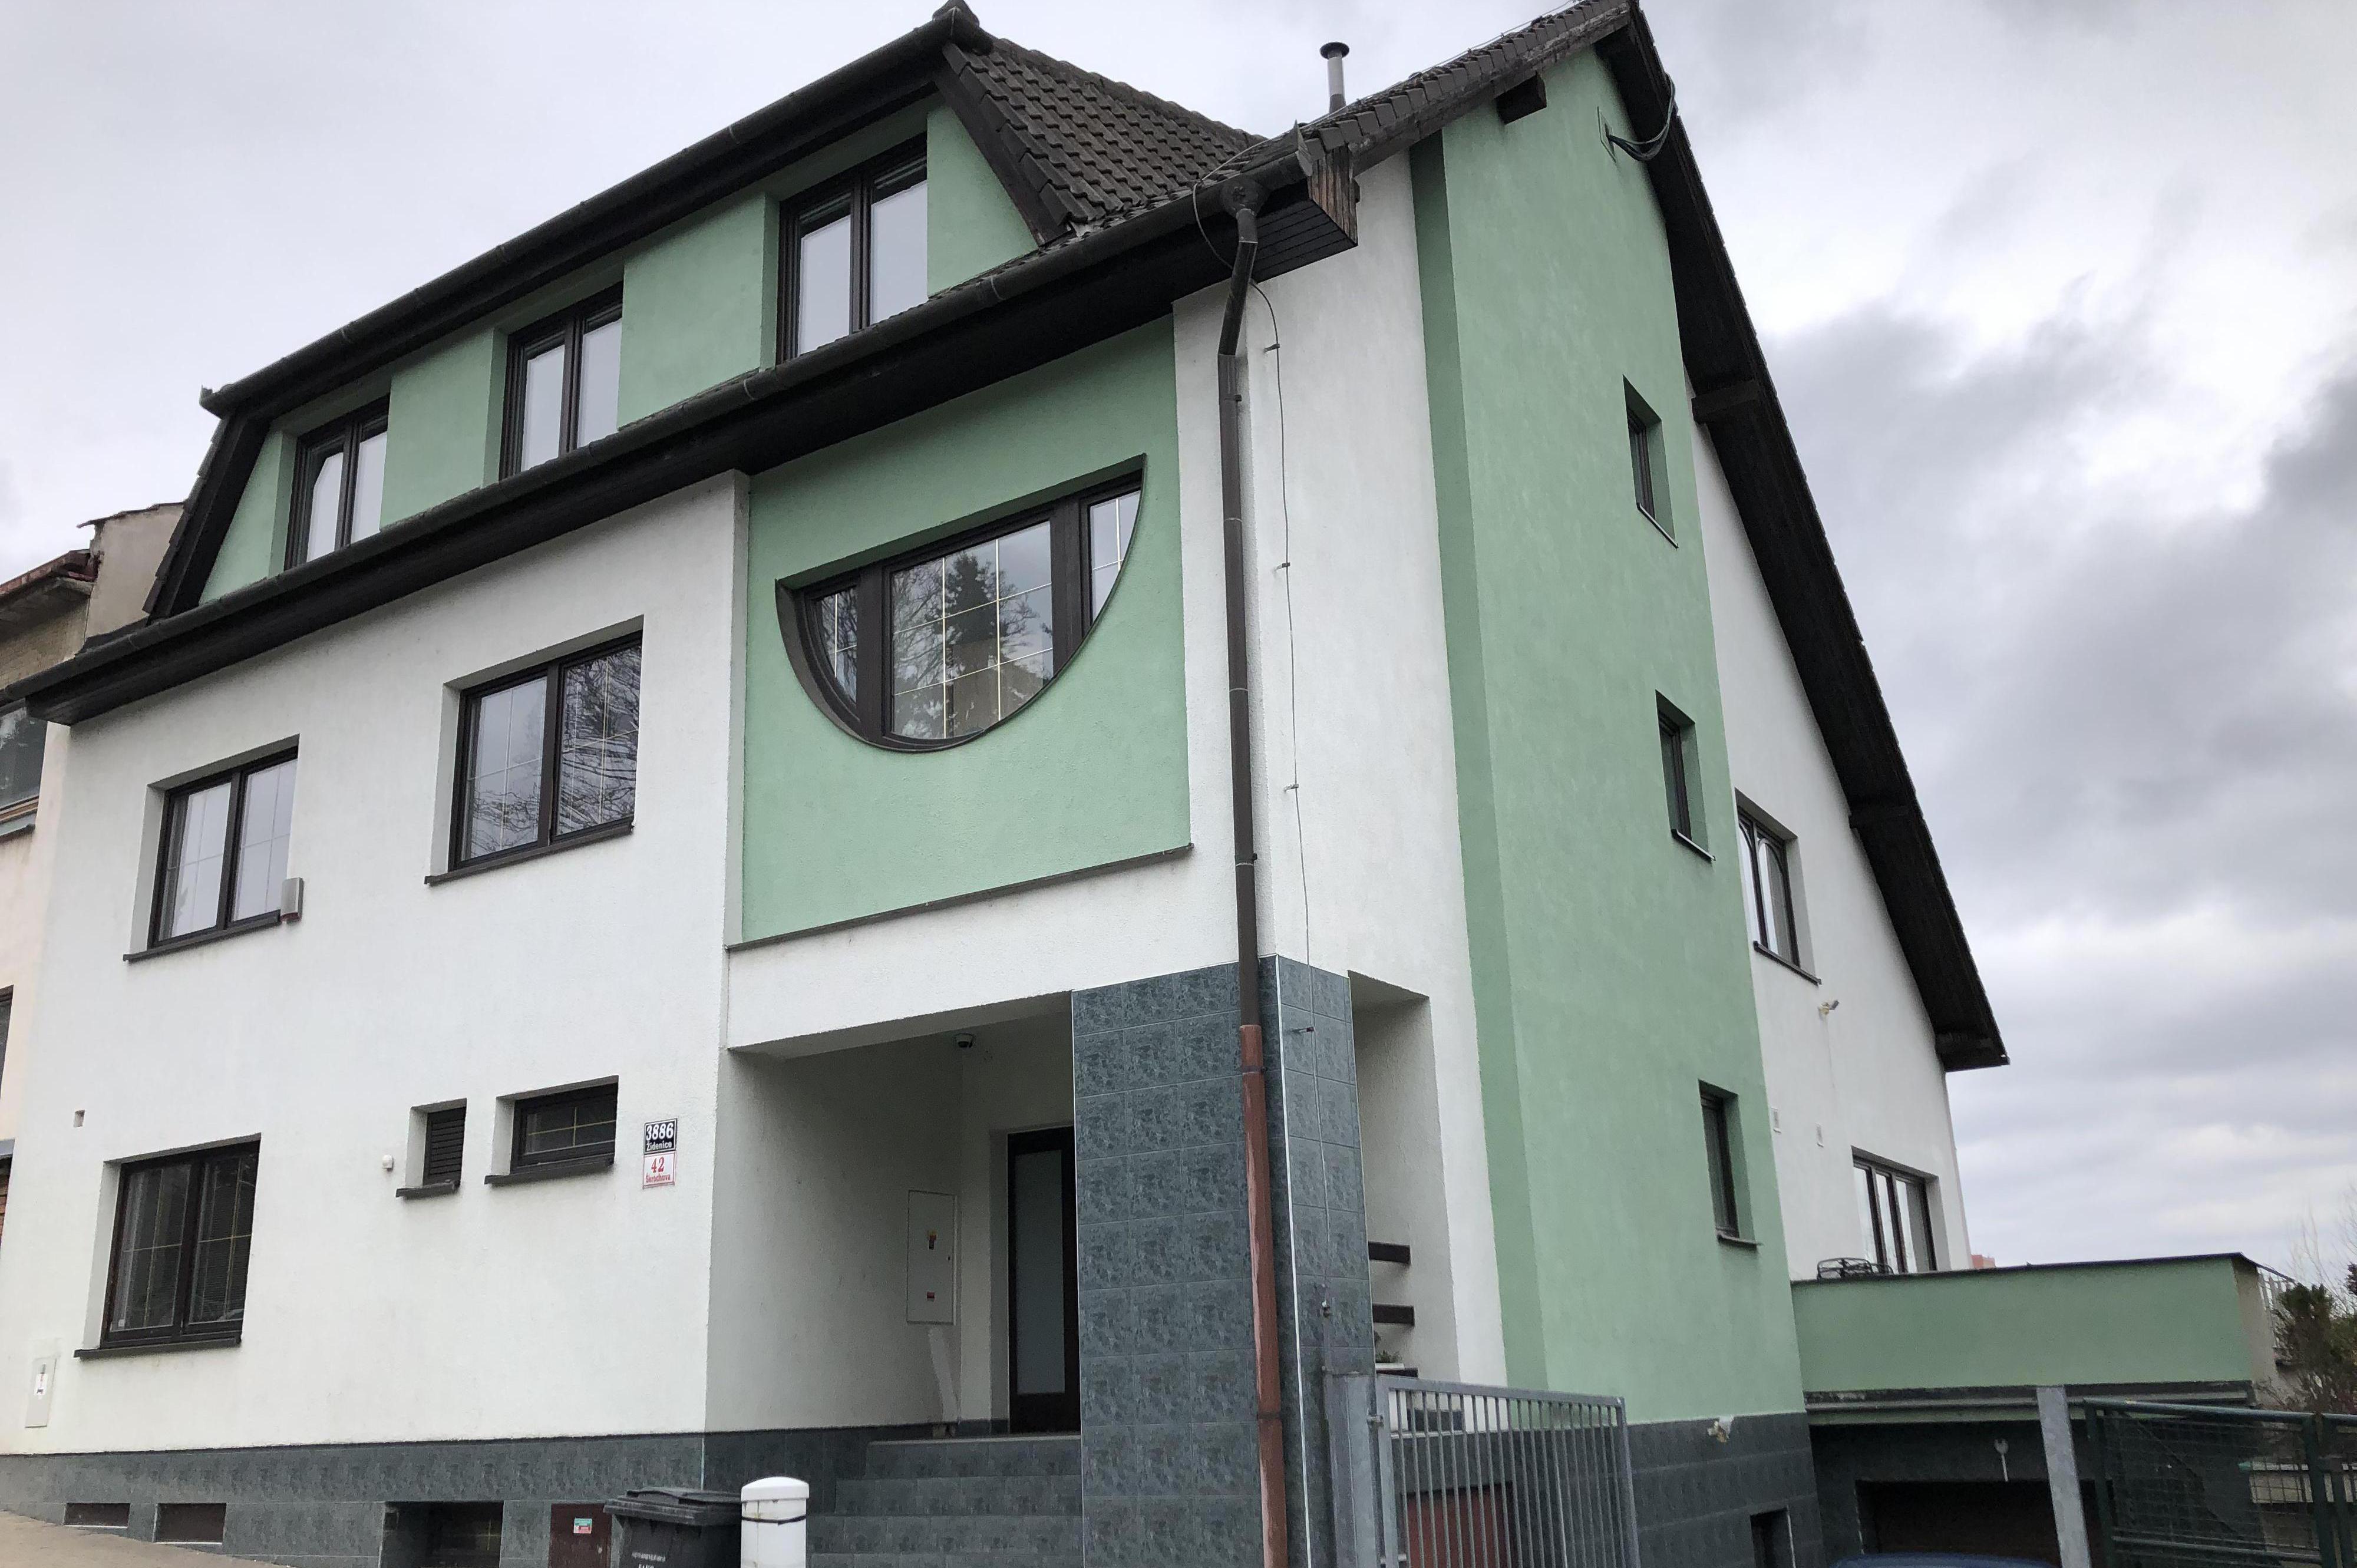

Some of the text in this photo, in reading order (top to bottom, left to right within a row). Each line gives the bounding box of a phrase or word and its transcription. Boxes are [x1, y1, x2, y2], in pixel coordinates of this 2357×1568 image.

[646, 1123, 674, 1141] 3886
[646, 1141, 672, 1151] Židenice
[651, 1157, 665, 1173] 42
